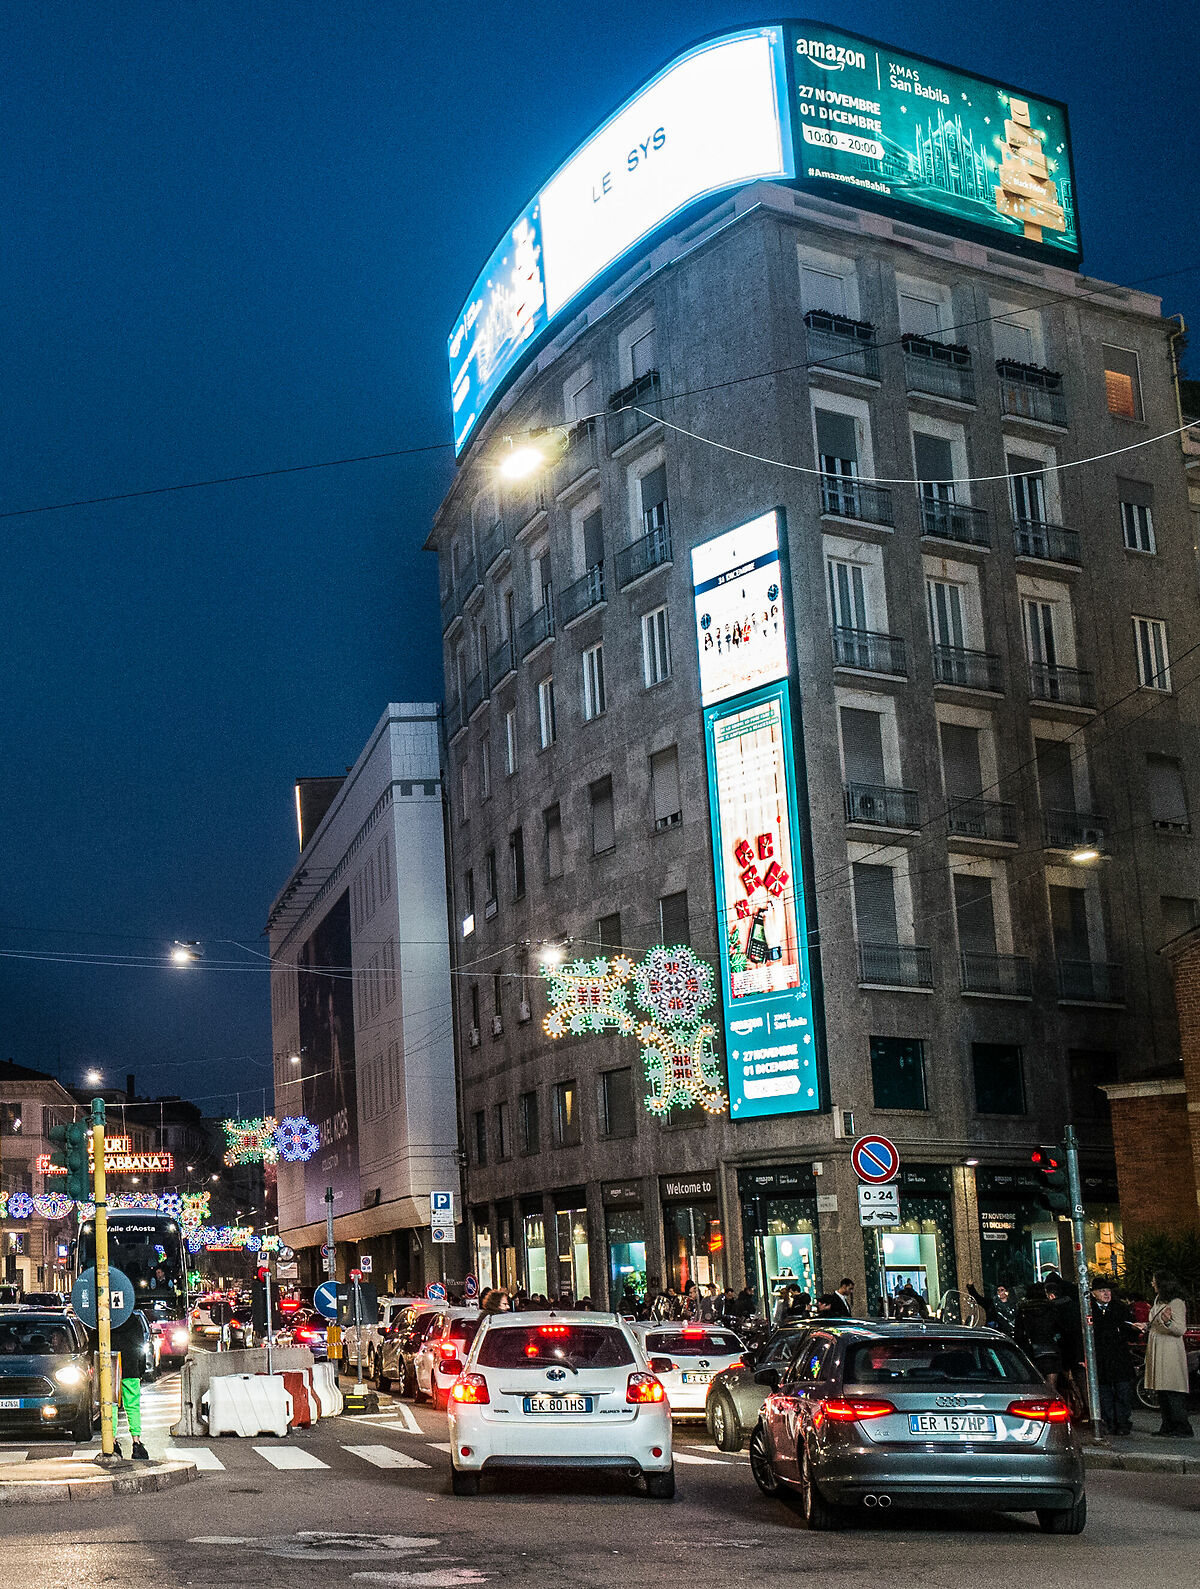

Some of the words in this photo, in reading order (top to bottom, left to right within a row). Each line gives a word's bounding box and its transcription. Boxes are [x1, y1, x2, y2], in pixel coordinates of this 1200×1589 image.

[796, 38, 866, 70] amazon
[888, 62, 920, 81] XMAS
[889, 74, 912, 92] San
[914, 79, 950, 105] Babila
[798, 85, 814, 99] 27
[815, 88, 881, 115] NOVEMBRE
[800, 102, 816, 116] 01
[819, 106, 882, 132] DICEMBRE
[807, 129, 838, 146] 10:00
[848, 138, 877, 155] 20:00
[592, 171, 613, 204] LE
[627, 126, 666, 172] SYS
[807, 167, 891, 195] #AmazonSanBabila
[742, 1050, 753, 1062] 27
[753, 1043, 799, 1061] NOVEMBRE
[743, 1065, 754, 1077] 01
[755, 1058, 800, 1076] DICEMBRE
[103, 1155, 161, 1169] GABBANA
[666, 1181, 702, 1196] Welcome
[702, 1180, 712, 1193] to
[437, 1194, 448, 1208] P
[981, 1212, 989, 1220] 27
[988, 1212, 1017, 1221] NOVEMBRE
[989, 1222, 1016, 1230] DICEMBRE
[125, 1224, 156, 1232] d'Aosta
[531, 1399, 545, 1411] EK
[548, 1399, 585, 1411] 801HS
[919, 1416, 938, 1432] ER
[943, 1416, 986, 1431] 157HP
